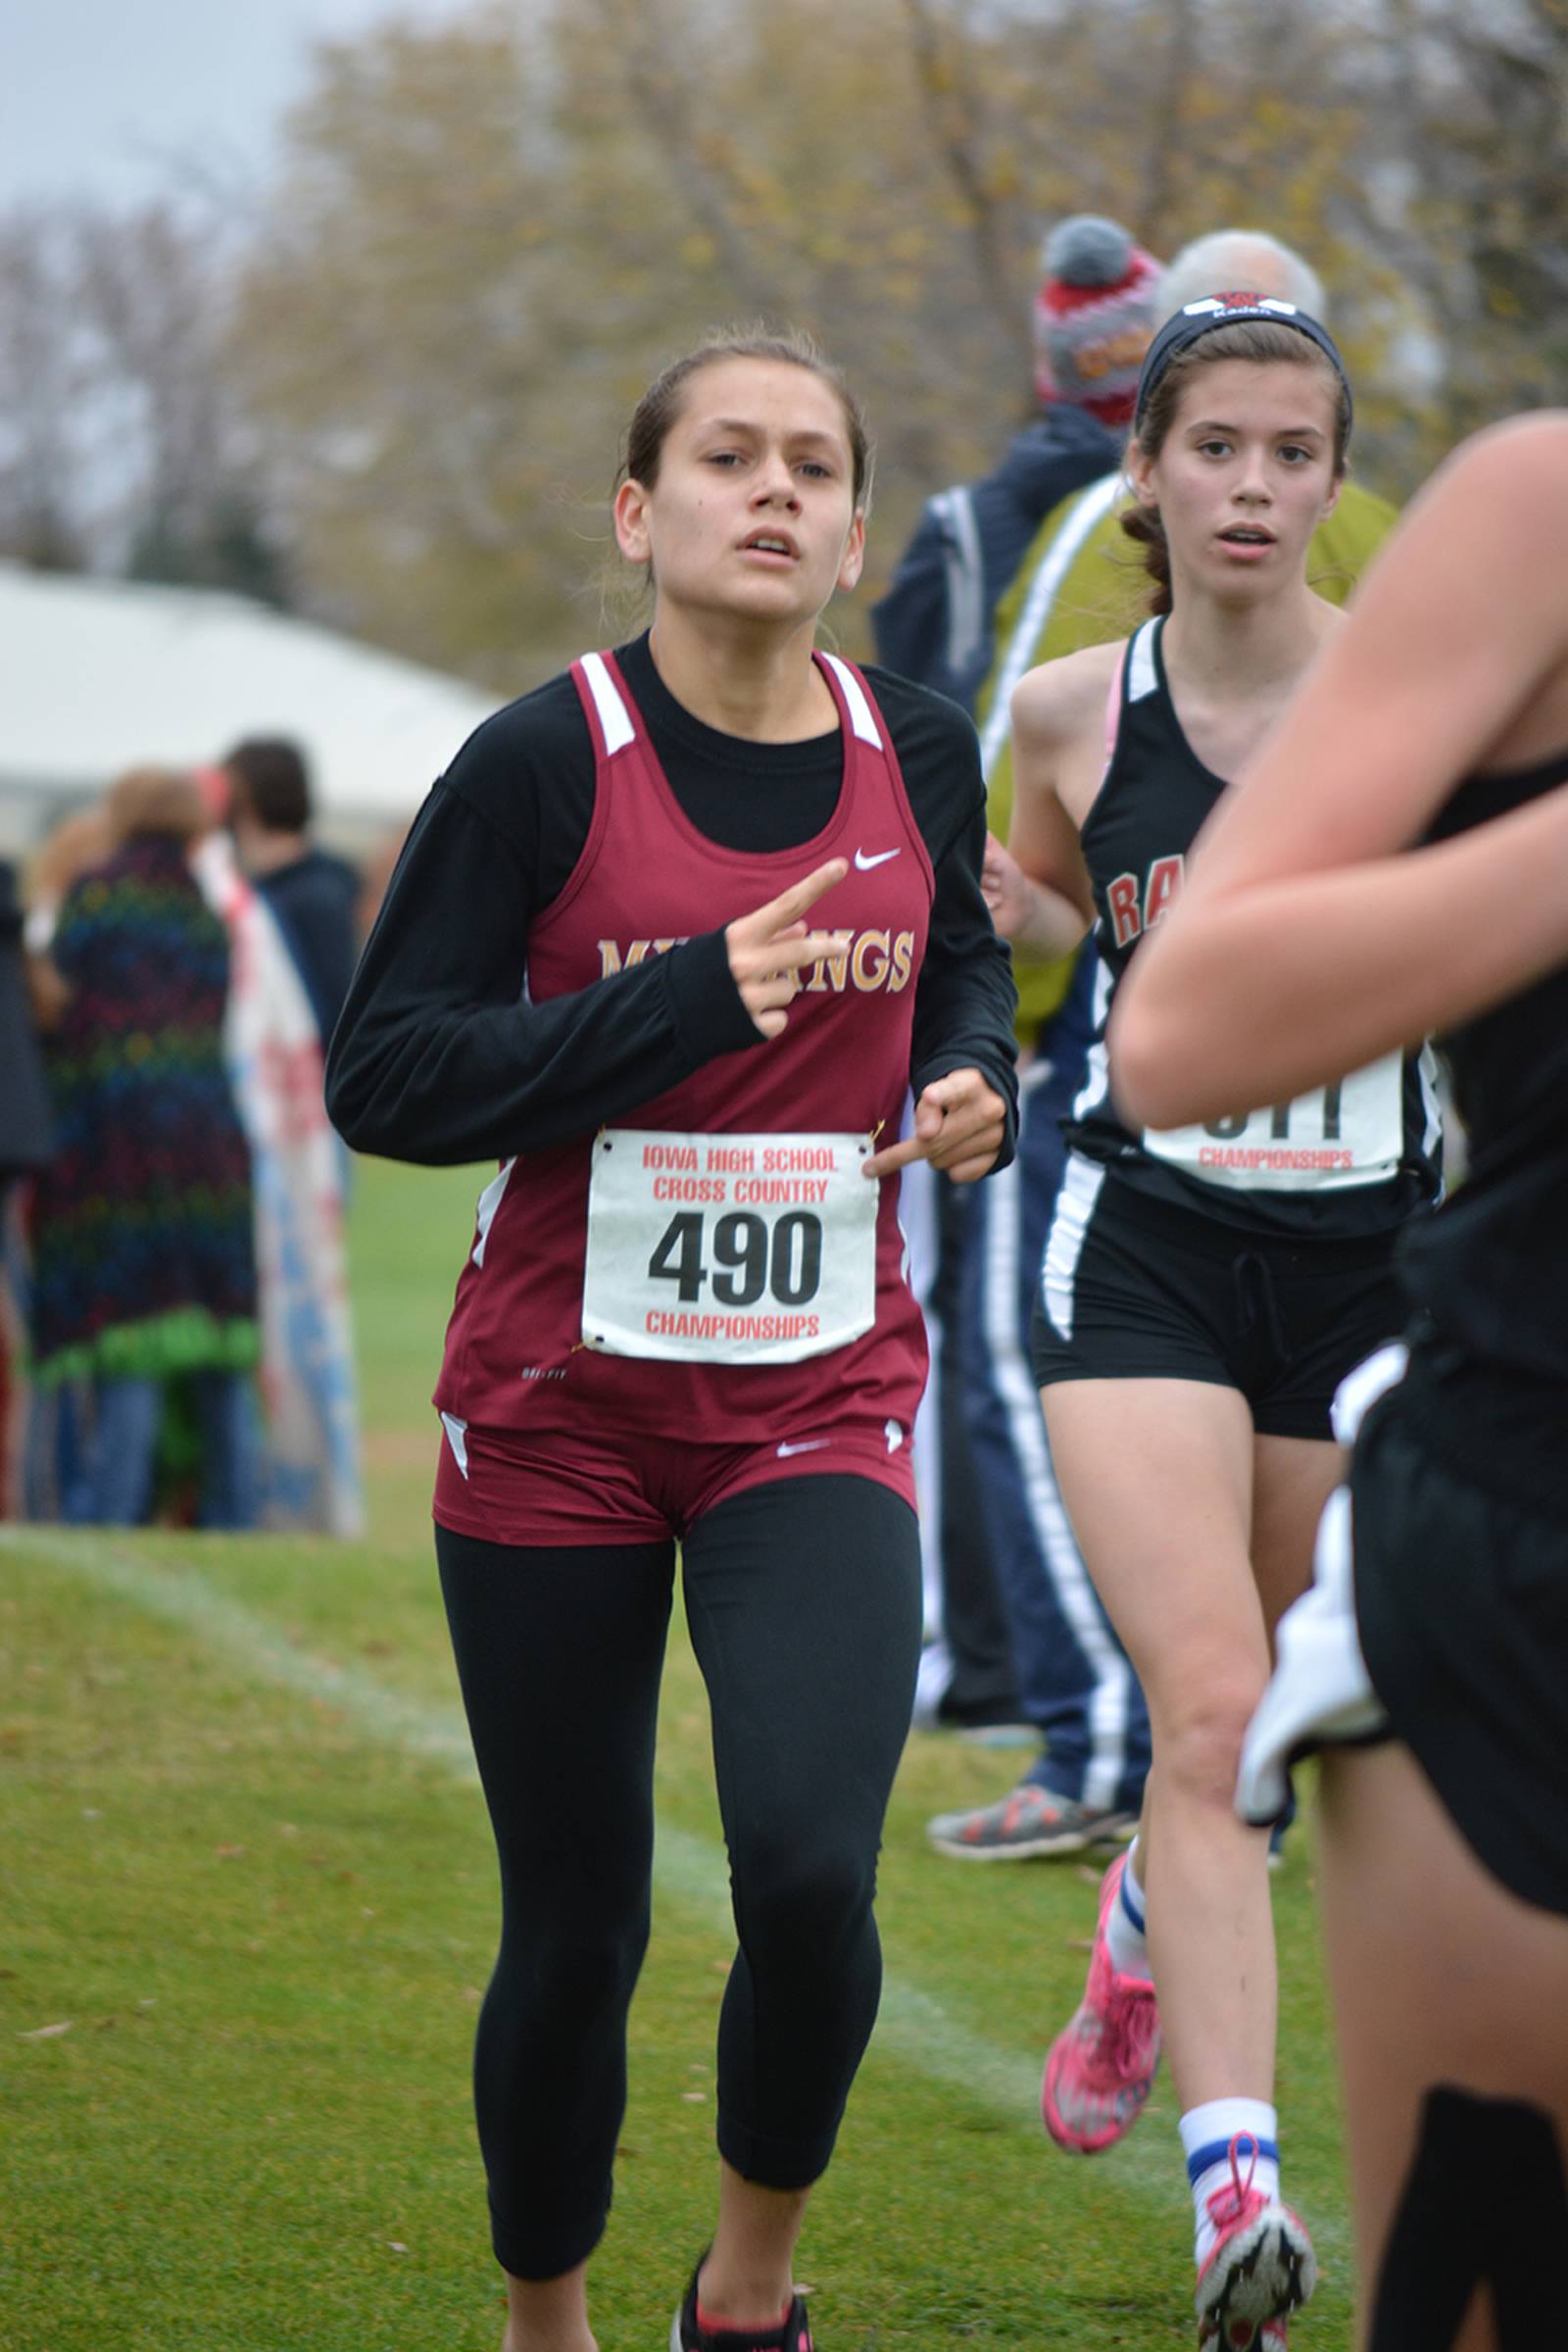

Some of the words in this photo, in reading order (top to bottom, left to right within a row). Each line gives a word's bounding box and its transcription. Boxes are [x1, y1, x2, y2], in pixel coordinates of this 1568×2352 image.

[643, 1144, 699, 1171] IOWA
[707, 1147, 755, 1173] HIGH
[762, 1147, 839, 1173] SCHOOL
[1199, 1146, 1353, 1170] CHAMPIONSHIPS
[653, 1176, 726, 1202] CROSS
[734, 1179, 828, 1203] COUNTRY
[648, 1210, 822, 1306] 490
[645, 1310, 820, 1341] CHAMPIONSHIPS
